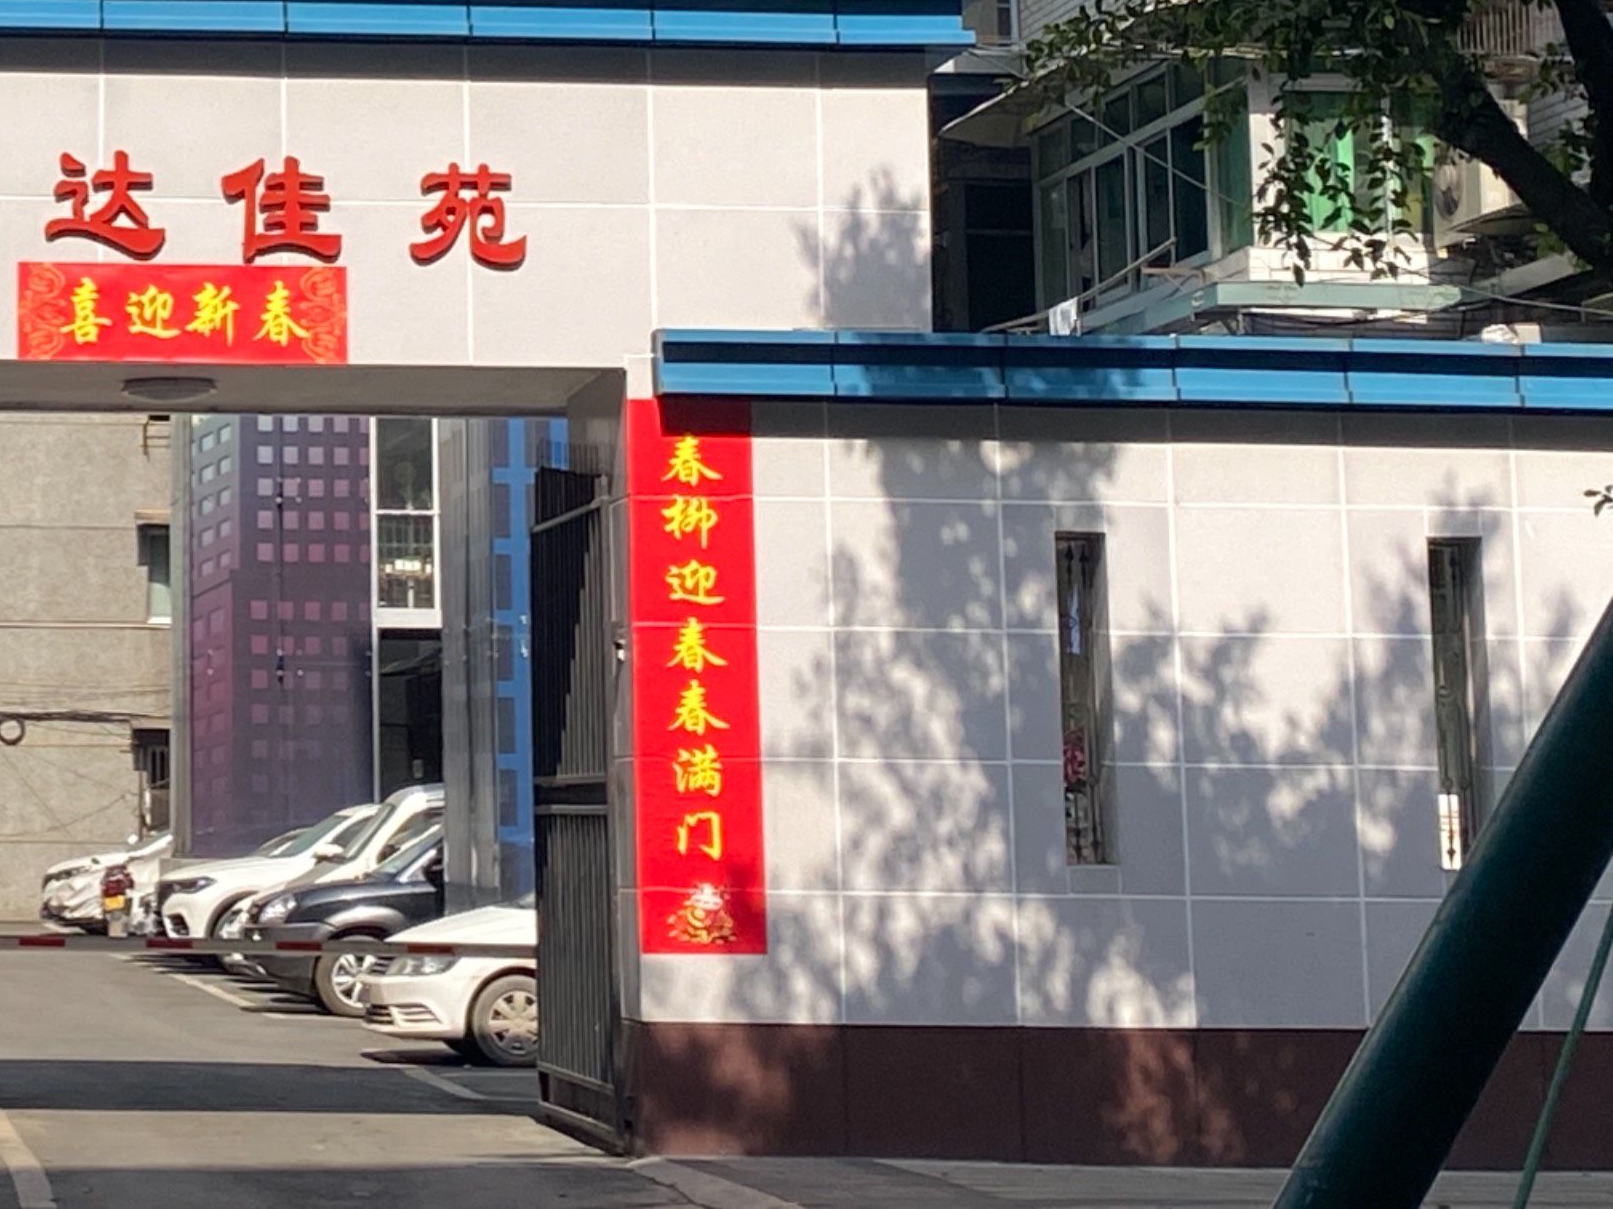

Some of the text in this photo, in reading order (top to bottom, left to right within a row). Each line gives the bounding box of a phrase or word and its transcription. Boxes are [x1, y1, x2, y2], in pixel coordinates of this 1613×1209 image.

[60, 276, 309, 346] 喜迎新春
[660, 435, 730, 861] 春柳迎春春满门
